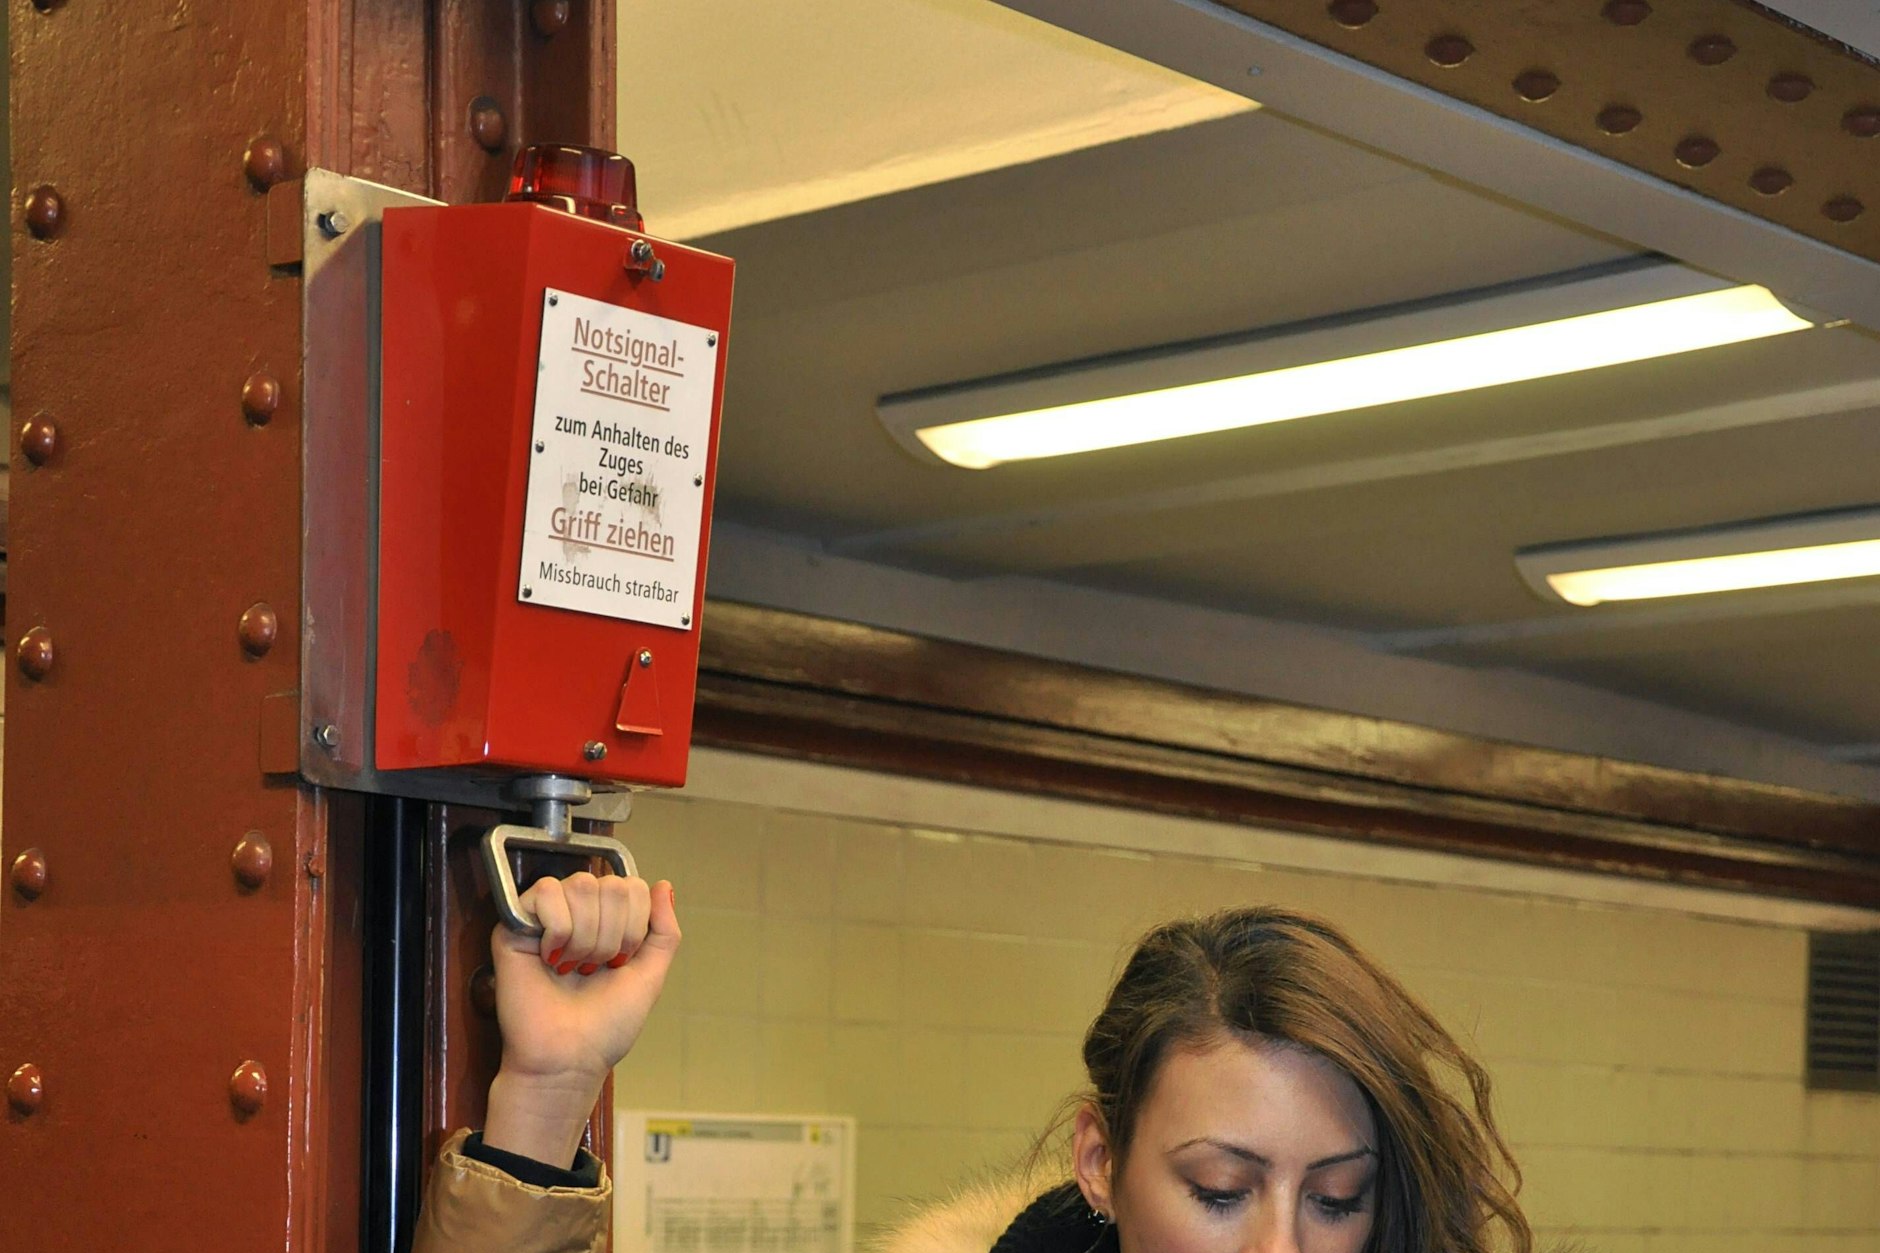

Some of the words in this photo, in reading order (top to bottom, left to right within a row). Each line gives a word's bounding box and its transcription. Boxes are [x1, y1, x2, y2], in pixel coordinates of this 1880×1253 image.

[574, 317, 684, 368] Notsignal-
[582, 359, 670, 405] Schalter
[555, 415, 587, 437] zum
[591, 420, 660, 453] Anhalten
[664, 436, 690, 460] des
[598, 447, 644, 477] Zuges
[579, 472, 603, 497] bei
[607, 479, 659, 508] Gefahr
[551, 506, 602, 541] Griff
[606, 518, 675, 556] ziehen
[539, 561, 621, 593] Missbrauch
[625, 580, 680, 604] strafbar
